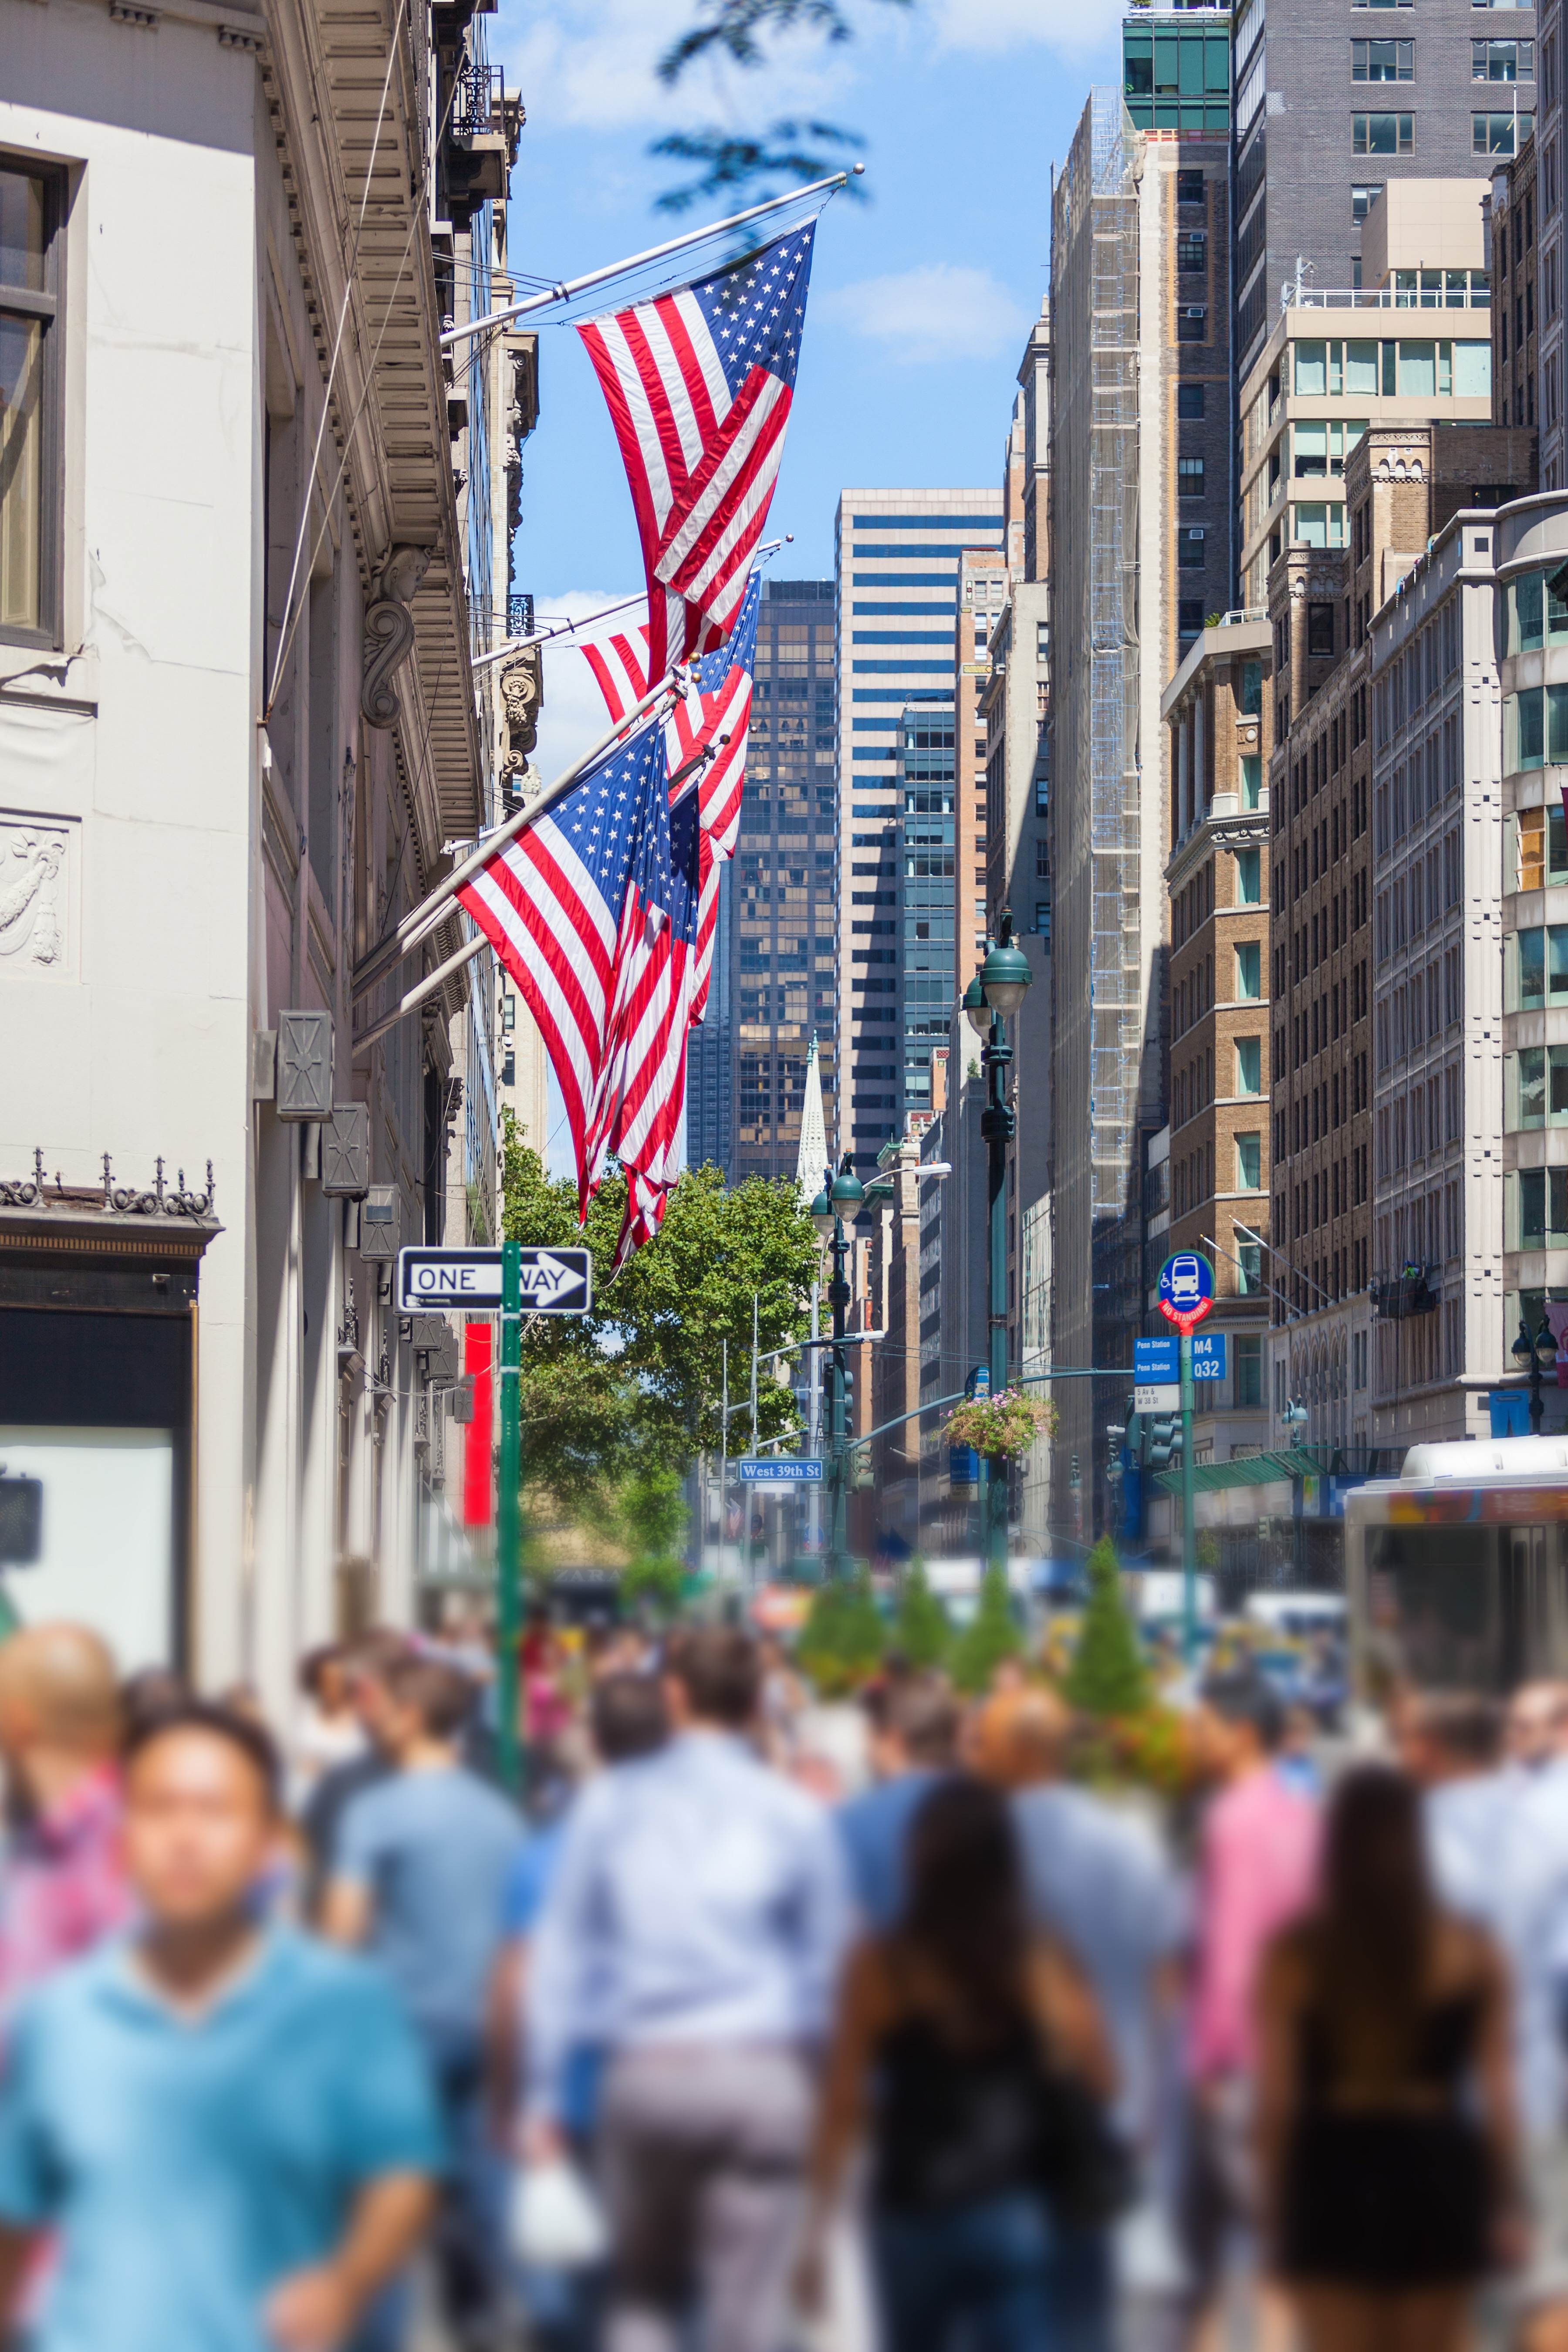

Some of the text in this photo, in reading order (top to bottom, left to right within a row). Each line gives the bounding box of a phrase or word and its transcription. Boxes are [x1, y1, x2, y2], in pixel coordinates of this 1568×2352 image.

[419, 1268, 476, 1291] ONE
[1162, 1301, 1207, 1321] NO STANDING
[1194, 1338, 1212, 1354] M4
[1194, 1361, 1219, 1377] Q32
[743, 1465, 819, 1477] West 39th St
[553, 1569, 622, 1582] ZARA
